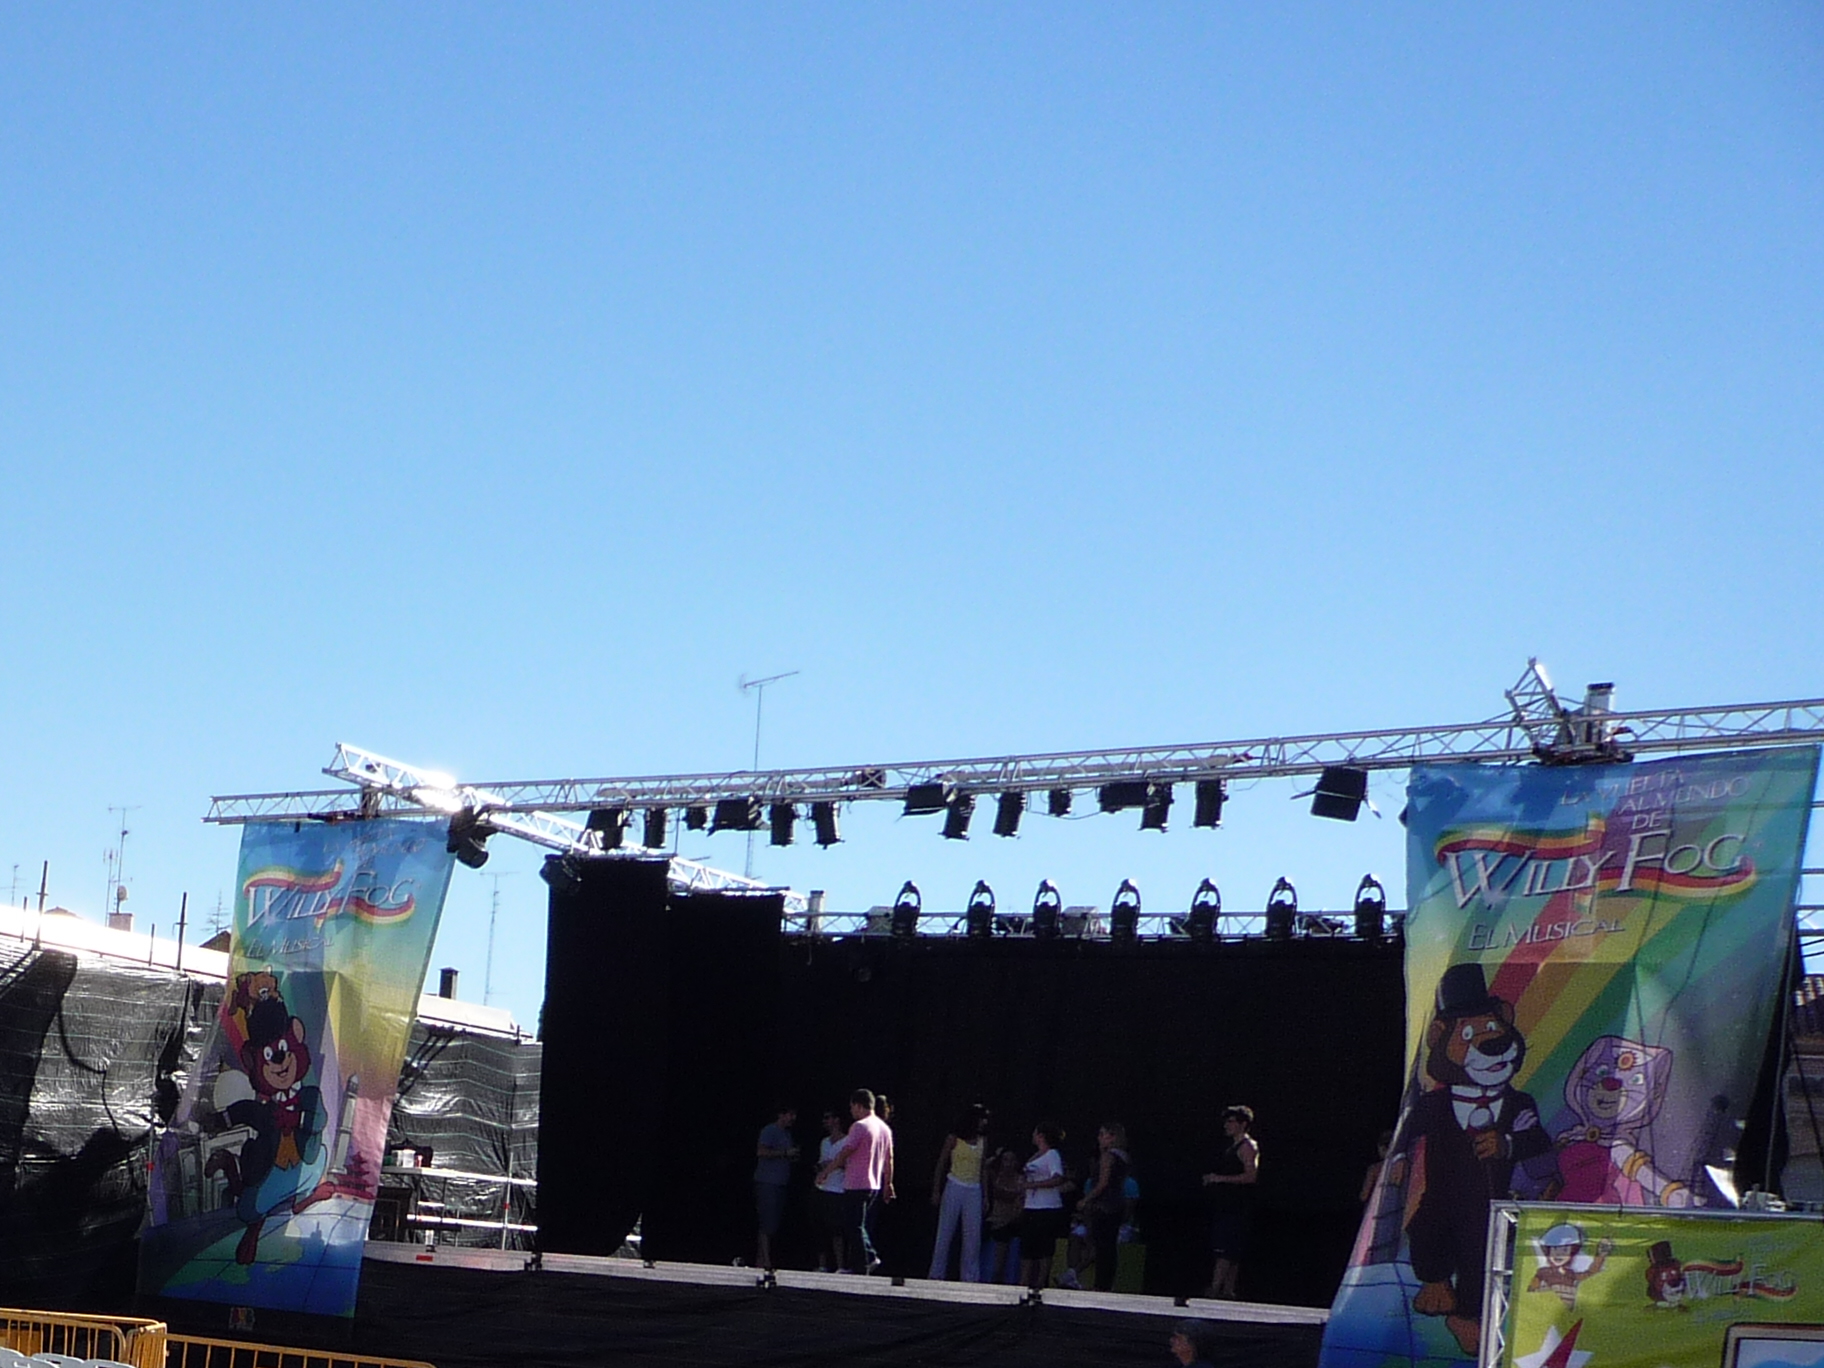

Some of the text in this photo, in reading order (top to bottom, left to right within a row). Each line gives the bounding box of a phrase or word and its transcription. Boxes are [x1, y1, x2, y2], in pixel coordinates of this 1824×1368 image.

[1654, 776, 1750, 808] MUNDO
[1632, 811, 1663, 829] DE
[1444, 829, 1746, 910] WILLY FOG
[247, 870, 414, 930] WILLY FOG
[1468, 917, 1625, 951] EL MUSICAL
